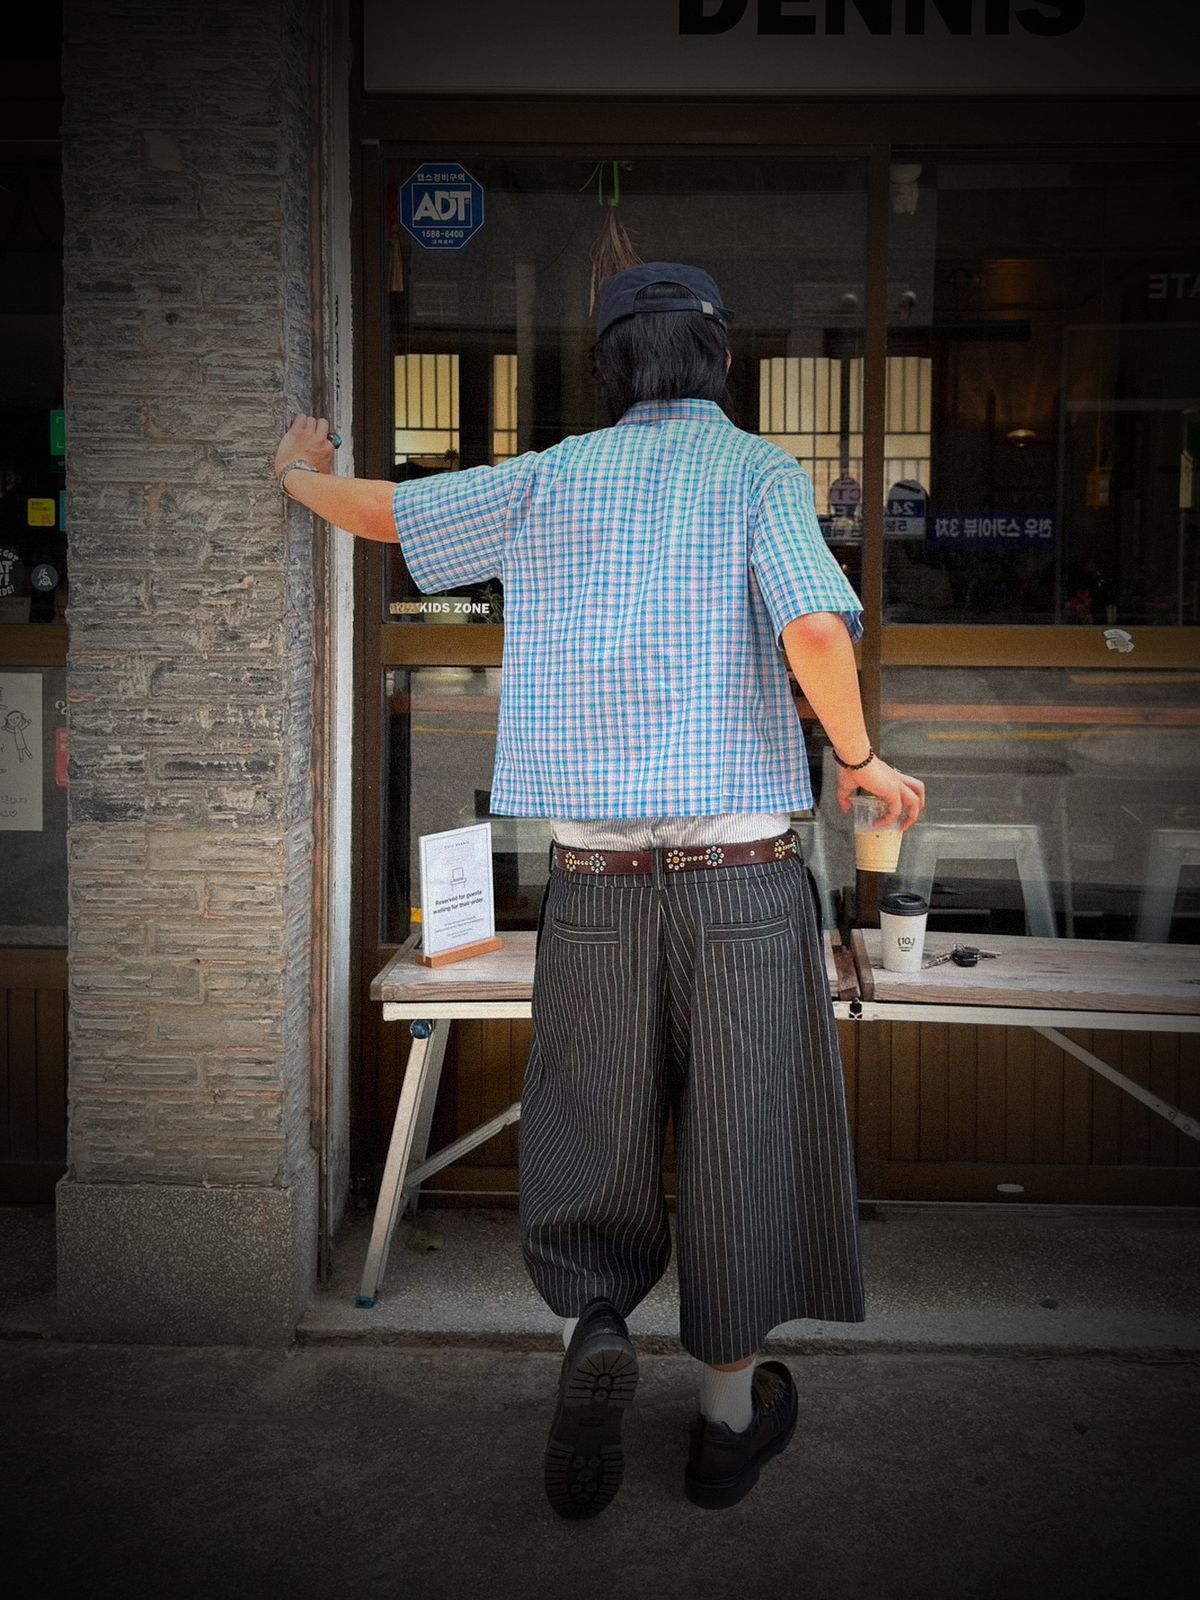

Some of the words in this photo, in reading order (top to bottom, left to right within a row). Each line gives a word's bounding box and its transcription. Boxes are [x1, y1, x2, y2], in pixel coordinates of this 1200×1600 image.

[679, 0, 1086, 36] DENNIS
[414, 191, 471, 221] ADT
[421, 230, 464, 238] 1588-6400
[420, 603, 450, 613] KIDS
[454, 603, 490, 613] ZONE
